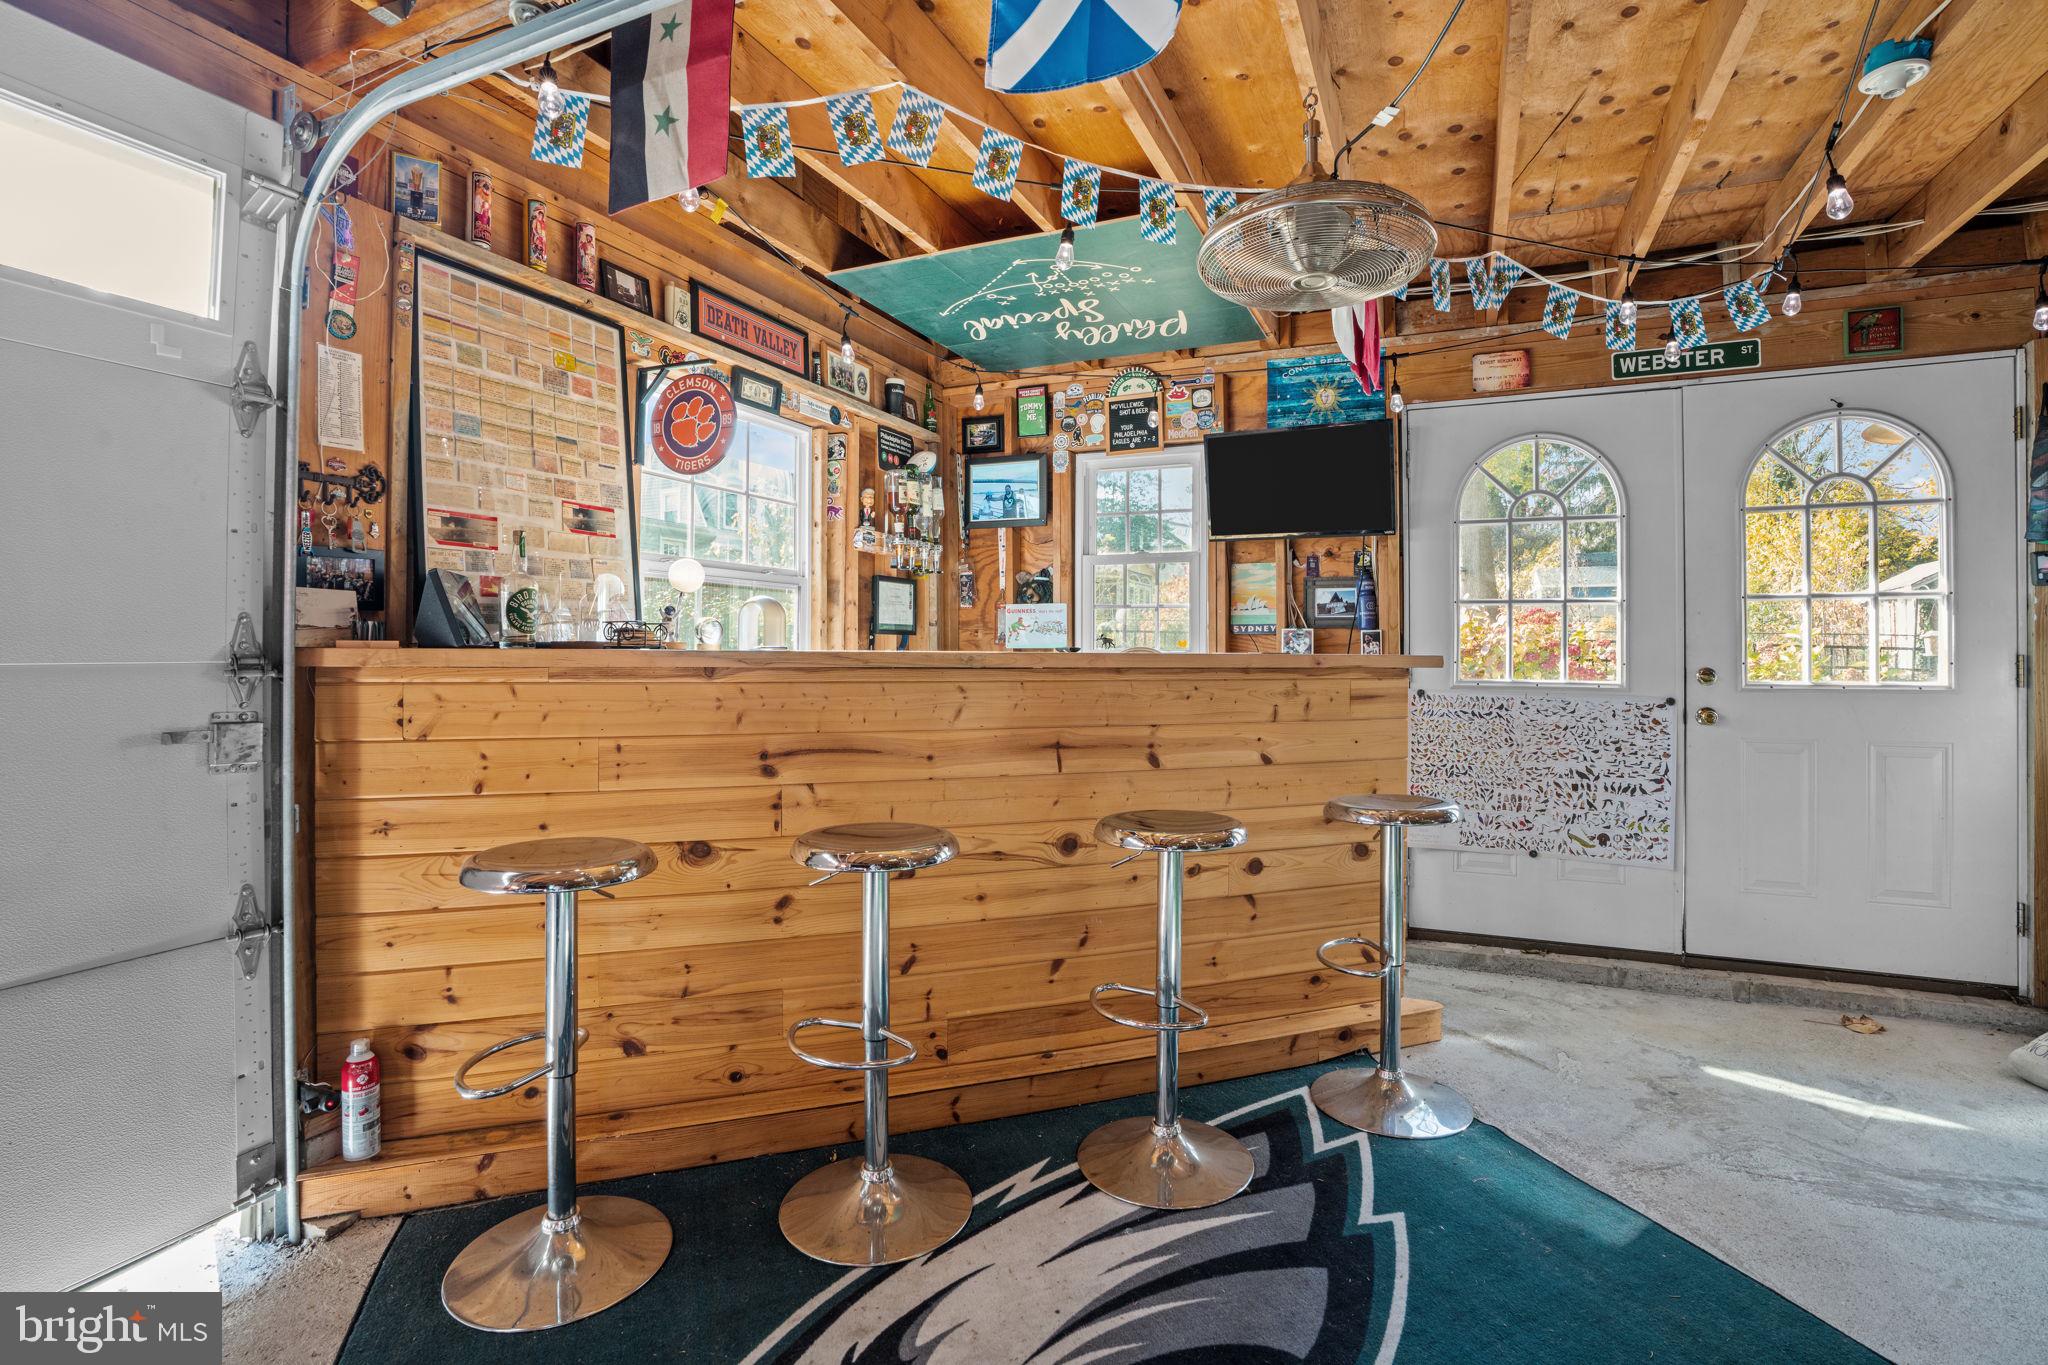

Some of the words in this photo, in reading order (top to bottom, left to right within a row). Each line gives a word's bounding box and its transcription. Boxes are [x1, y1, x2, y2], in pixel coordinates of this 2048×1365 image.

[964, 298, 1105, 341] Special
[706, 304, 749, 339] DEATH
[752, 325, 799, 360] VALLEY
[1055, 310, 1188, 346] Philly
[1619, 348, 1725, 374] WEBSTER
[1741, 345, 1754, 354] ST
[666, 378, 717, 400] CLEMSON
[1020, 402, 1043, 411] TOMMY
[723, 414, 732, 425] 89
[1026, 413, 1037, 421] ME
[653, 423, 661, 434] 18
[1121, 423, 1134, 431] YOUR
[1113, 429, 1148, 438] PHILADELPHIA
[1168, 429, 1199, 440] MedMen
[675, 454, 711, 470] TIGERS
[510, 590, 529, 608] BIRD
[1233, 625, 1276, 633] SYDNEY
